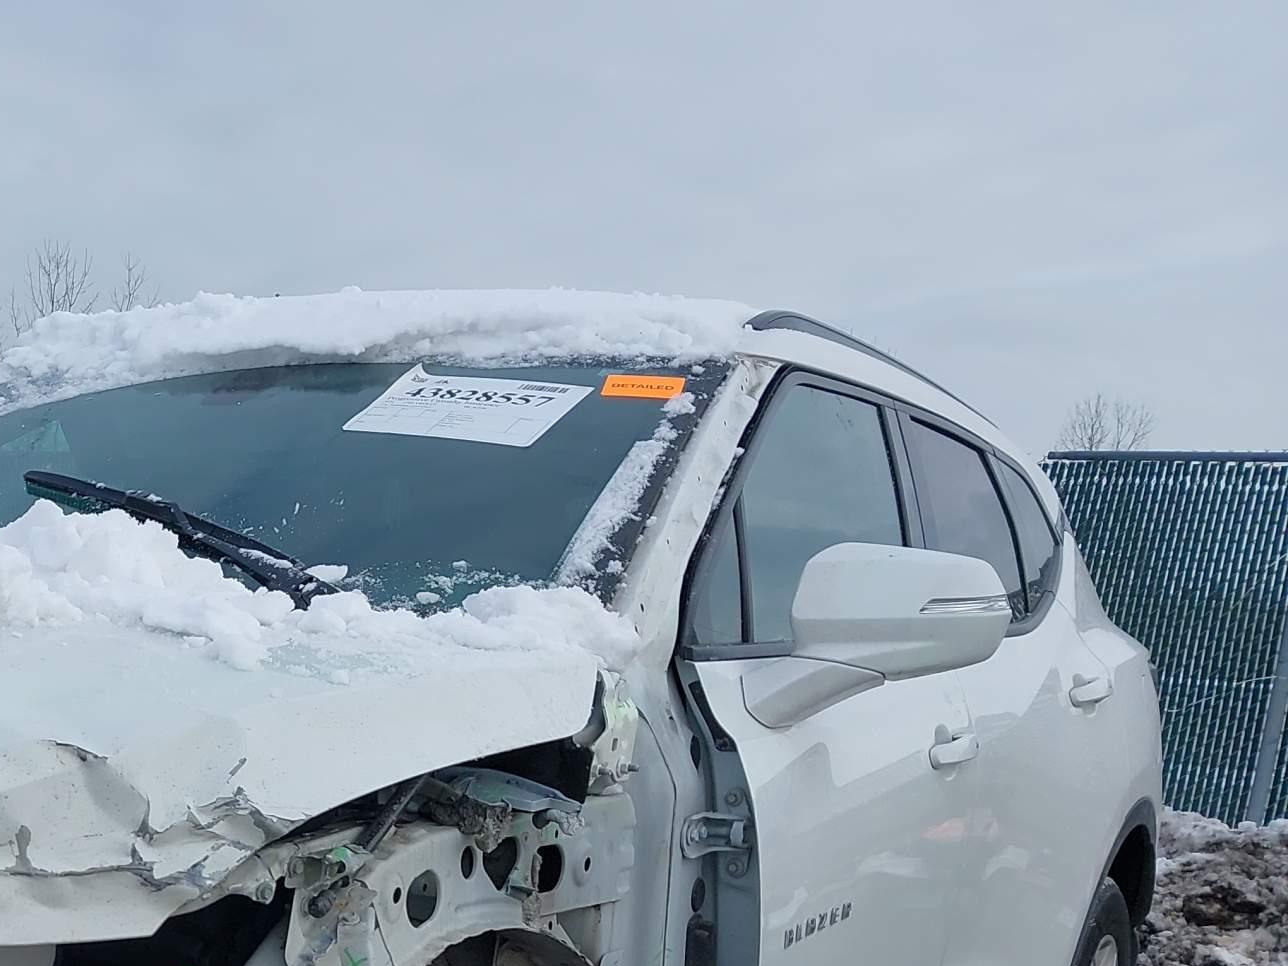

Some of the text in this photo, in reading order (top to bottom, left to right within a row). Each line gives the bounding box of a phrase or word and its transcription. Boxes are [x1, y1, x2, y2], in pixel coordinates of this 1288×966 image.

[404, 387, 556, 407] 43828557
[610, 383, 675, 391] DETAILED
[783, 902, 852, 950] BLAZER
